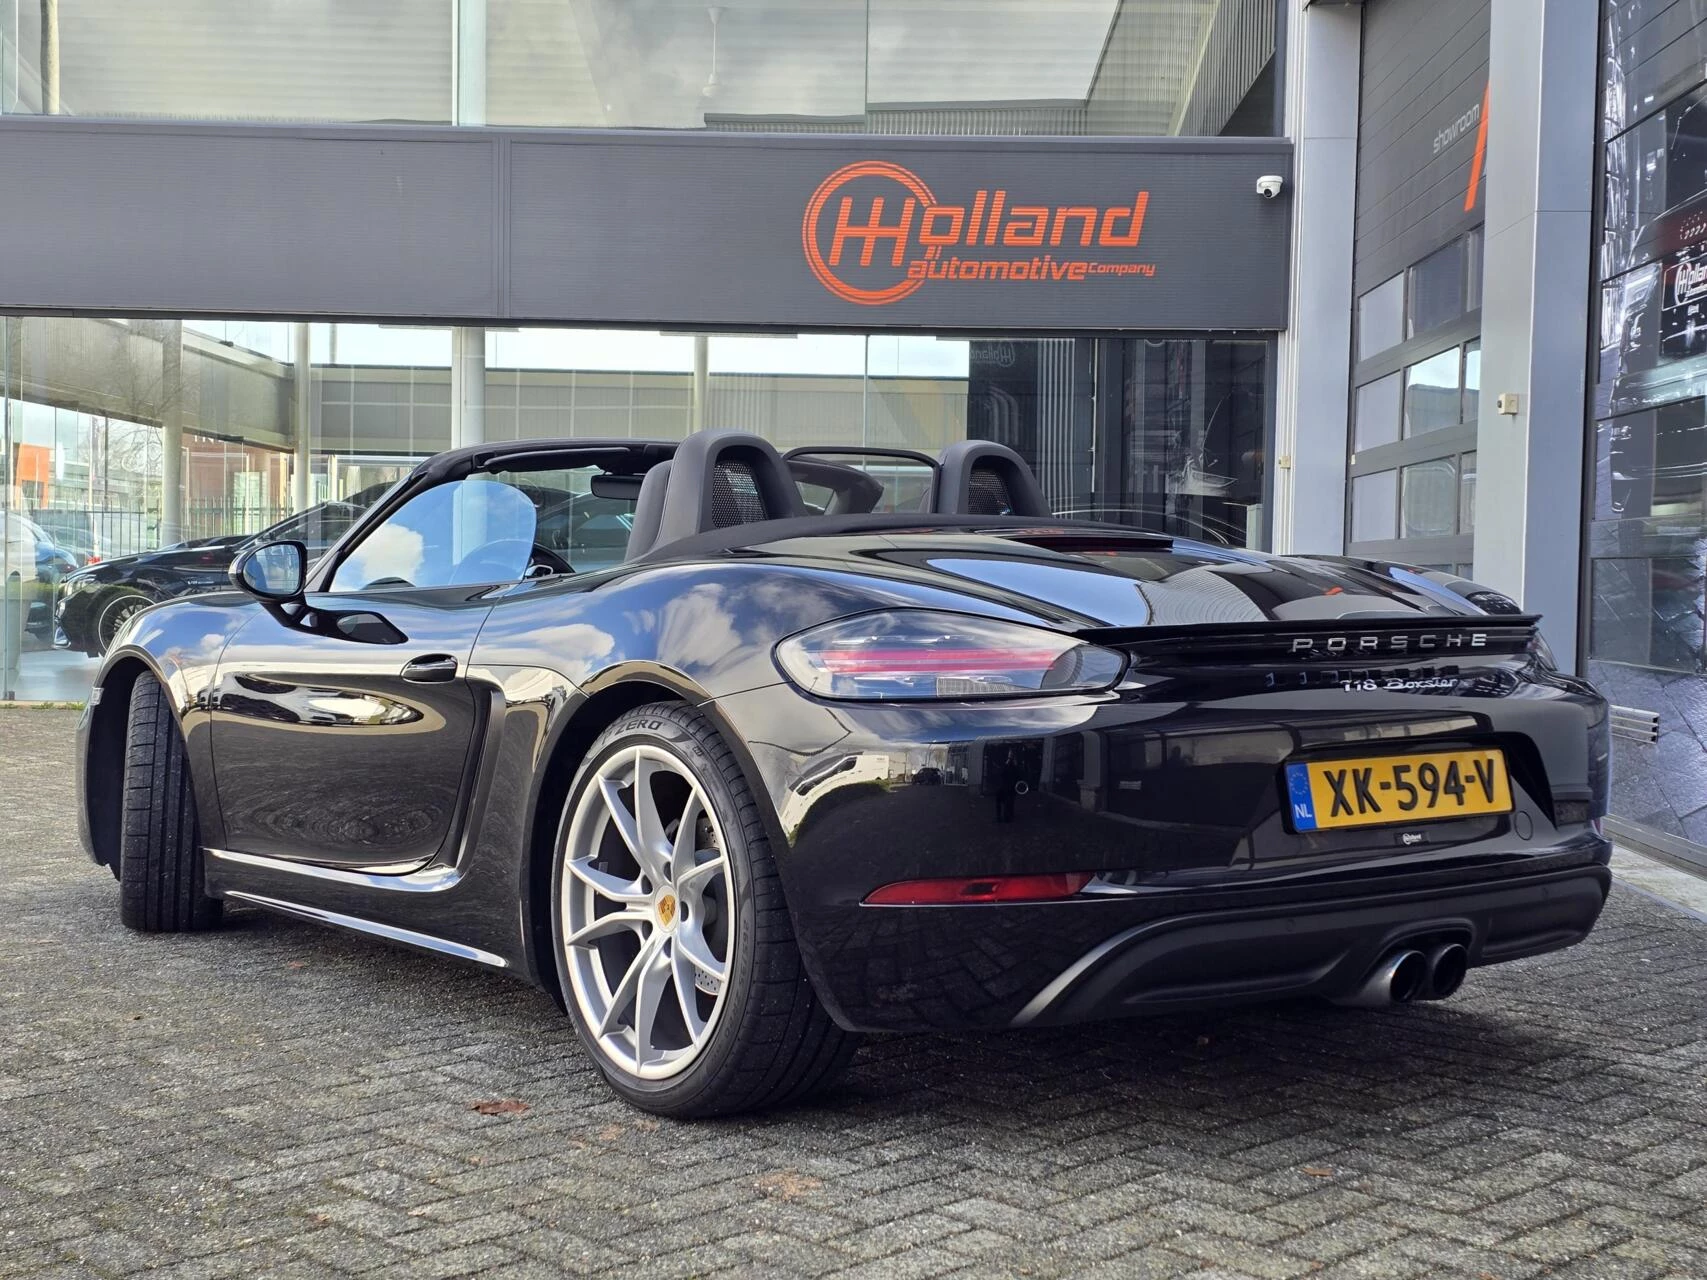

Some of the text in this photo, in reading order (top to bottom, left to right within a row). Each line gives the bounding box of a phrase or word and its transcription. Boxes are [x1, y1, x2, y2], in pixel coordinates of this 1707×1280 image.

[1433, 104, 1479, 153] showroom
[828, 190, 1149, 267] Holland
[907, 255, 1155, 280] automotive Company
[1292, 633, 1487, 652] PORSCHE
[1340, 677, 1458, 692] 718 Boxster
[614, 719, 664, 736] ZERO
[1323, 758, 1495, 818] XK-594-V
[1294, 804, 1312, 819] NL
